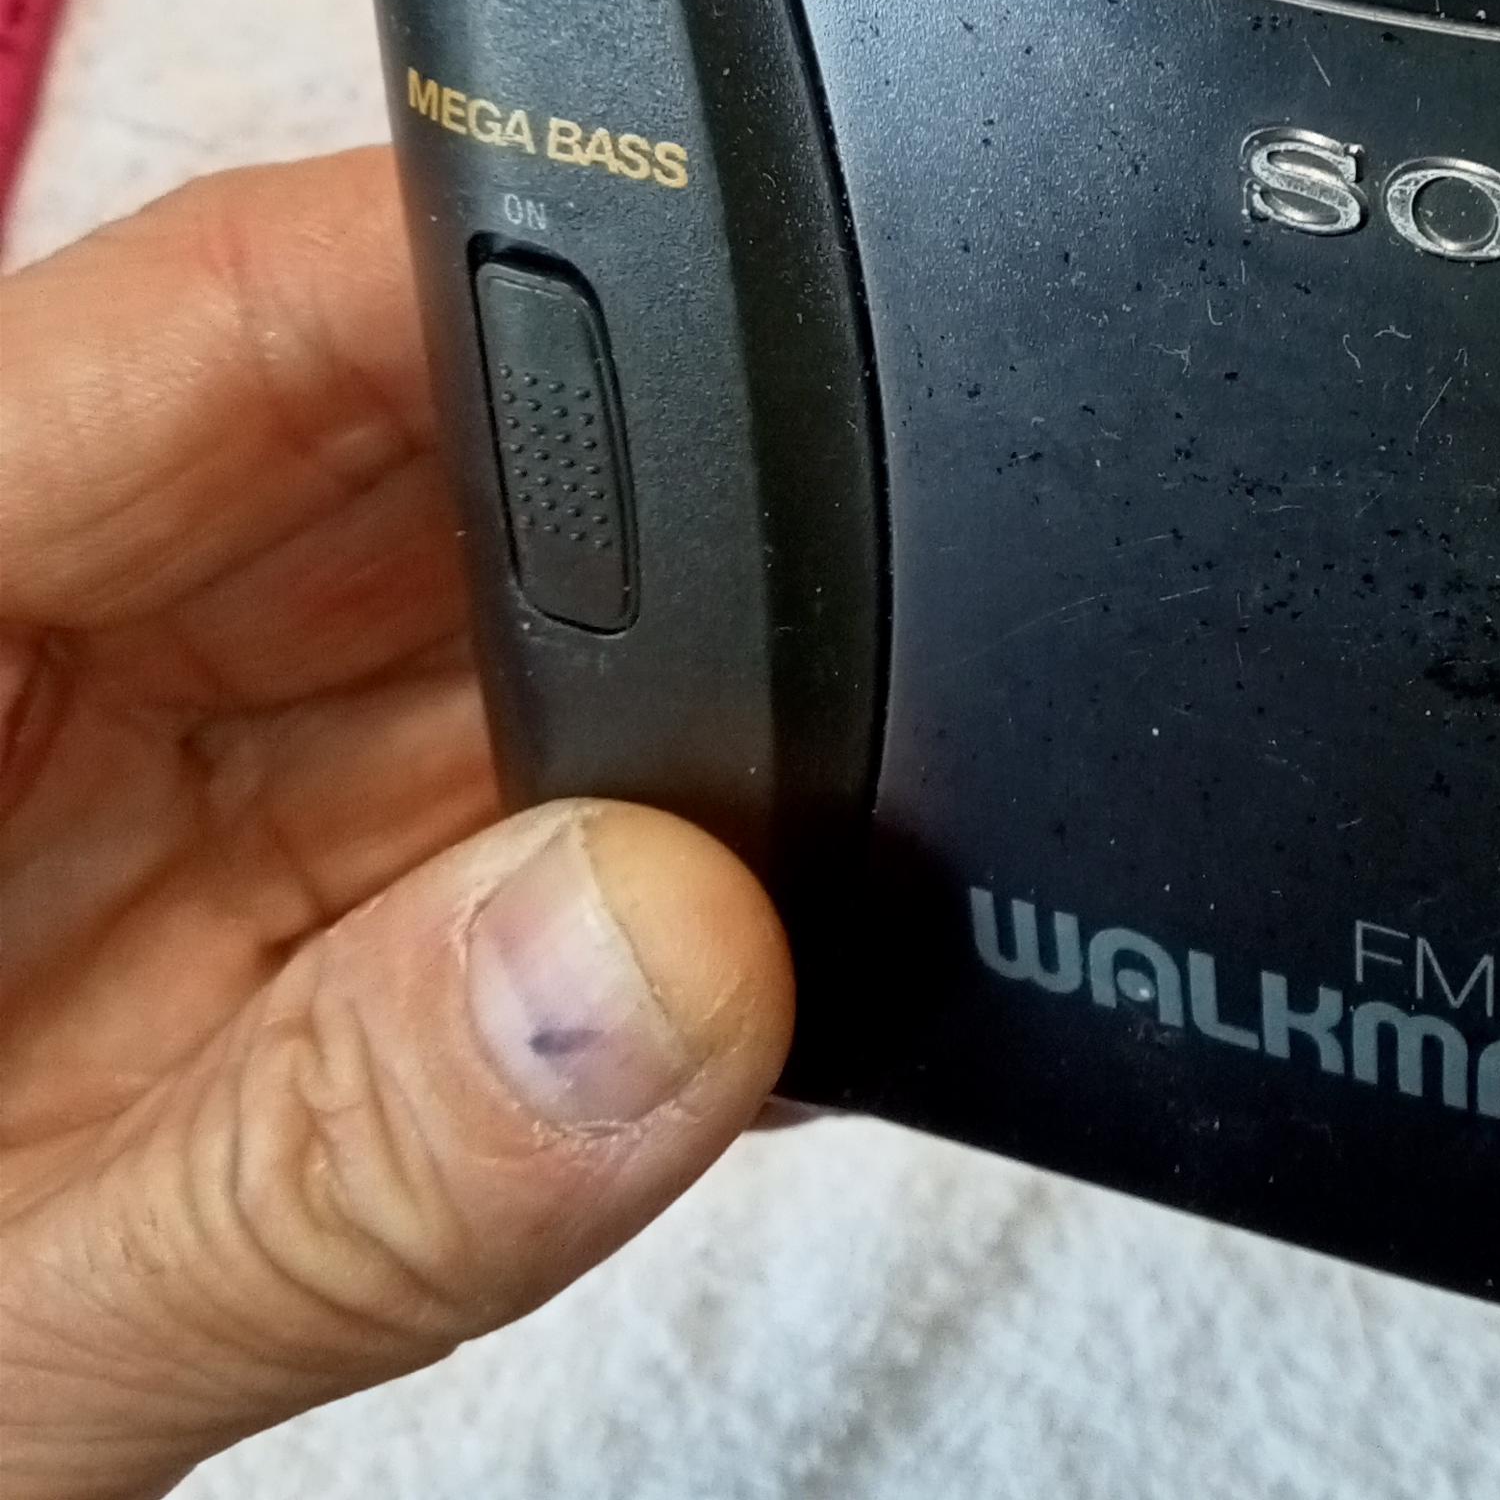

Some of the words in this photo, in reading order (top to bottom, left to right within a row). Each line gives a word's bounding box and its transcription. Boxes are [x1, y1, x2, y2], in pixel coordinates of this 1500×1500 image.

[407, 66, 536, 155] MEGA
[547, 117, 689, 189] BASS
[504, 193, 547, 230] ON
